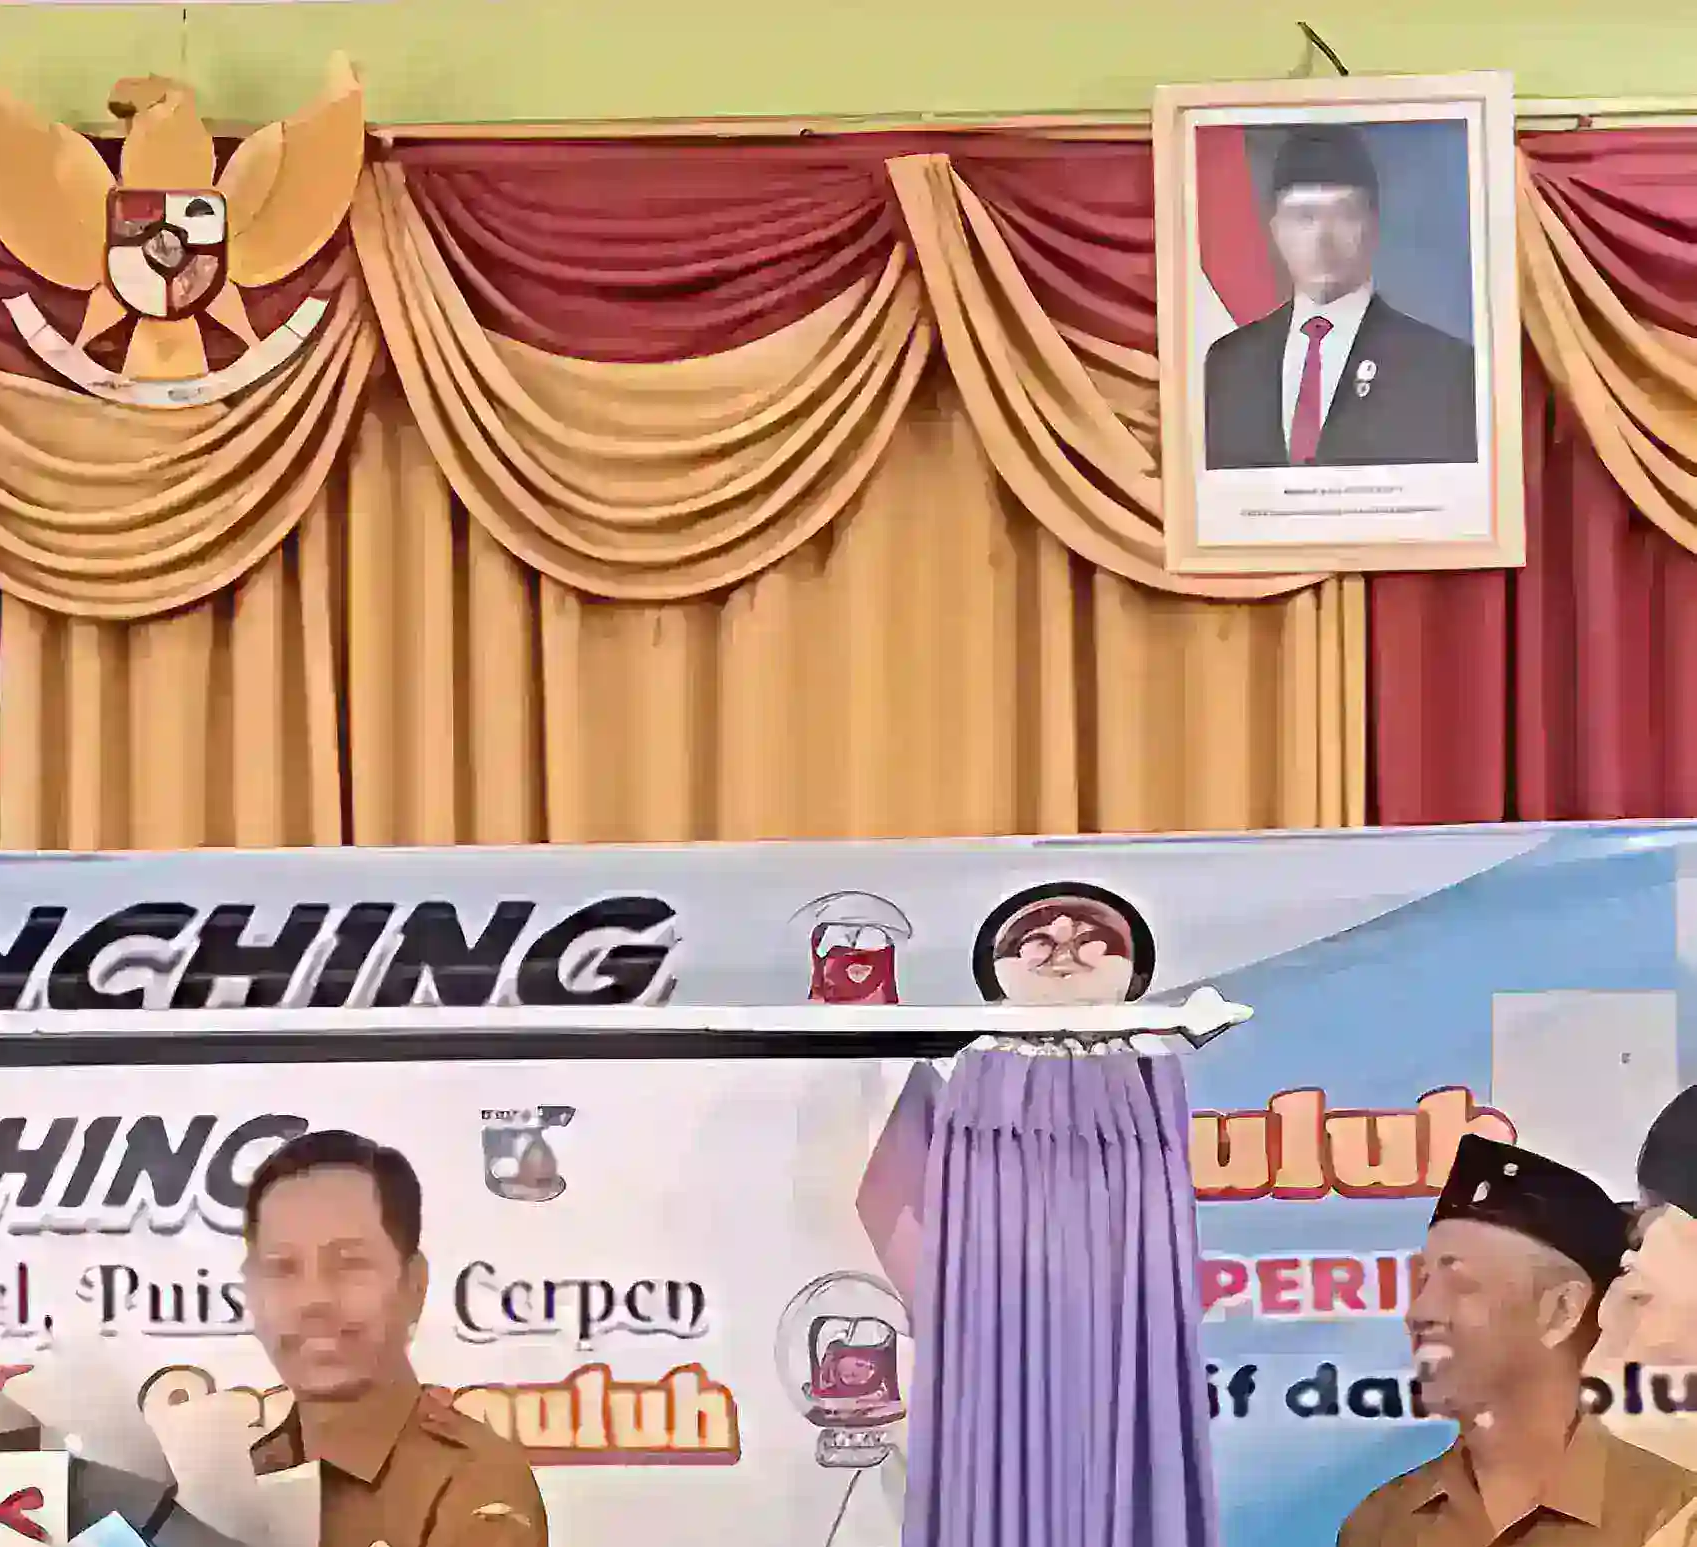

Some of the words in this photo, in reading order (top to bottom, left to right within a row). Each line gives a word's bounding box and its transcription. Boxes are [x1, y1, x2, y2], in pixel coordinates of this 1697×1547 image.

[1189, 1085, 1518, 1200] uluh
[76, 1263, 245, 1324] Puis
[454, 1259, 706, 1342] Cerpen
[1196, 1257, 1400, 1313] PERI
